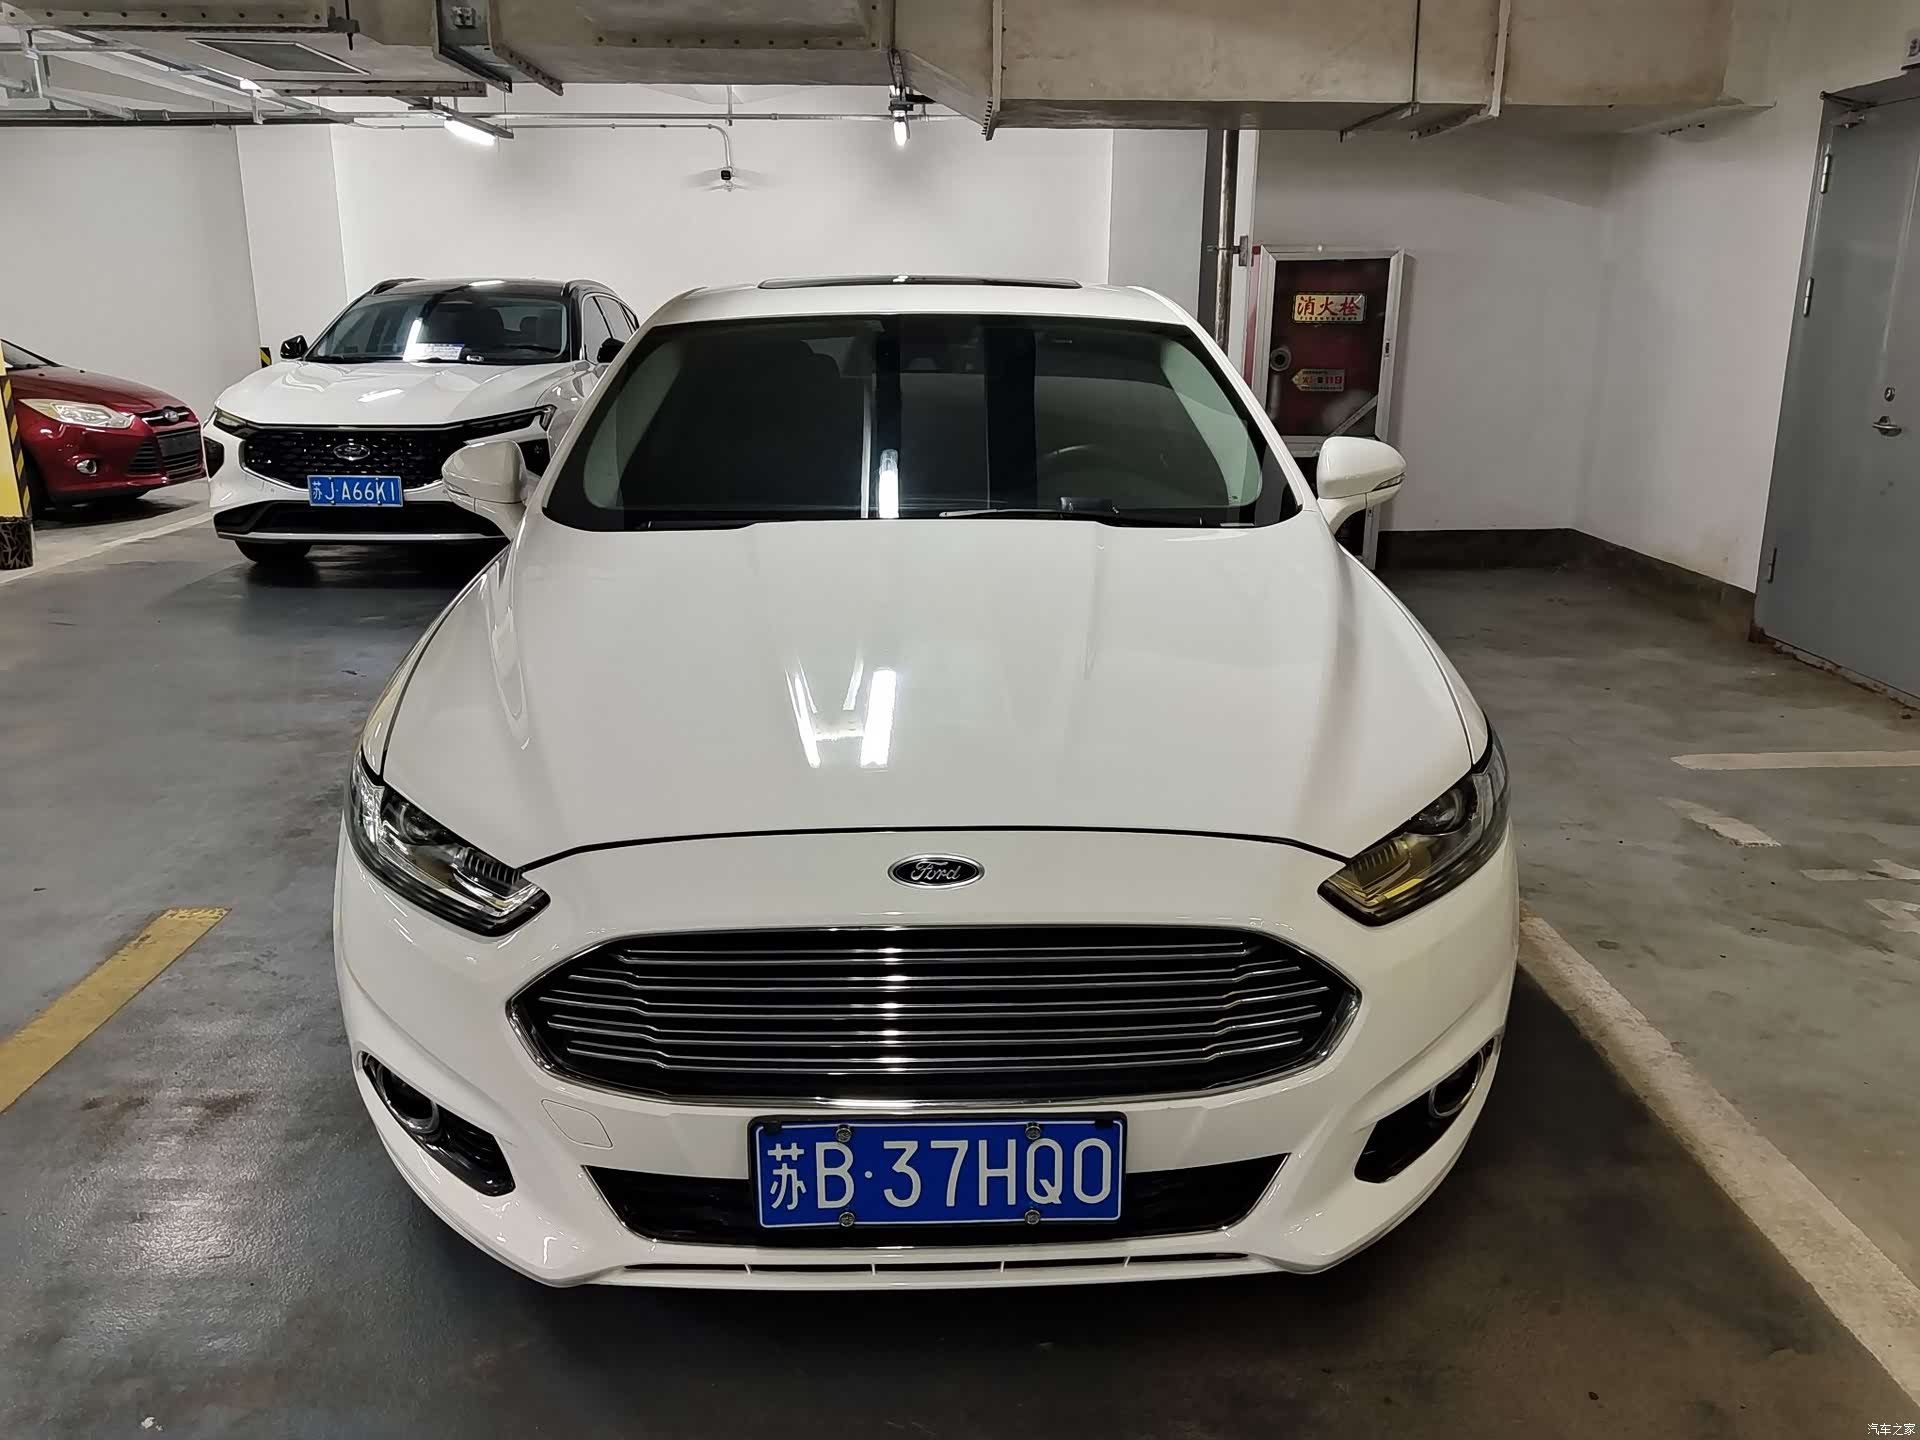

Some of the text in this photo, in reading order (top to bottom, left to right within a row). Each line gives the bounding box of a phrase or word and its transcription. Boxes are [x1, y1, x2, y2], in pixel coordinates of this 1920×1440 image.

[1297, 296, 1361, 316] 消火栓
[911, 861, 961, 881] Ford
